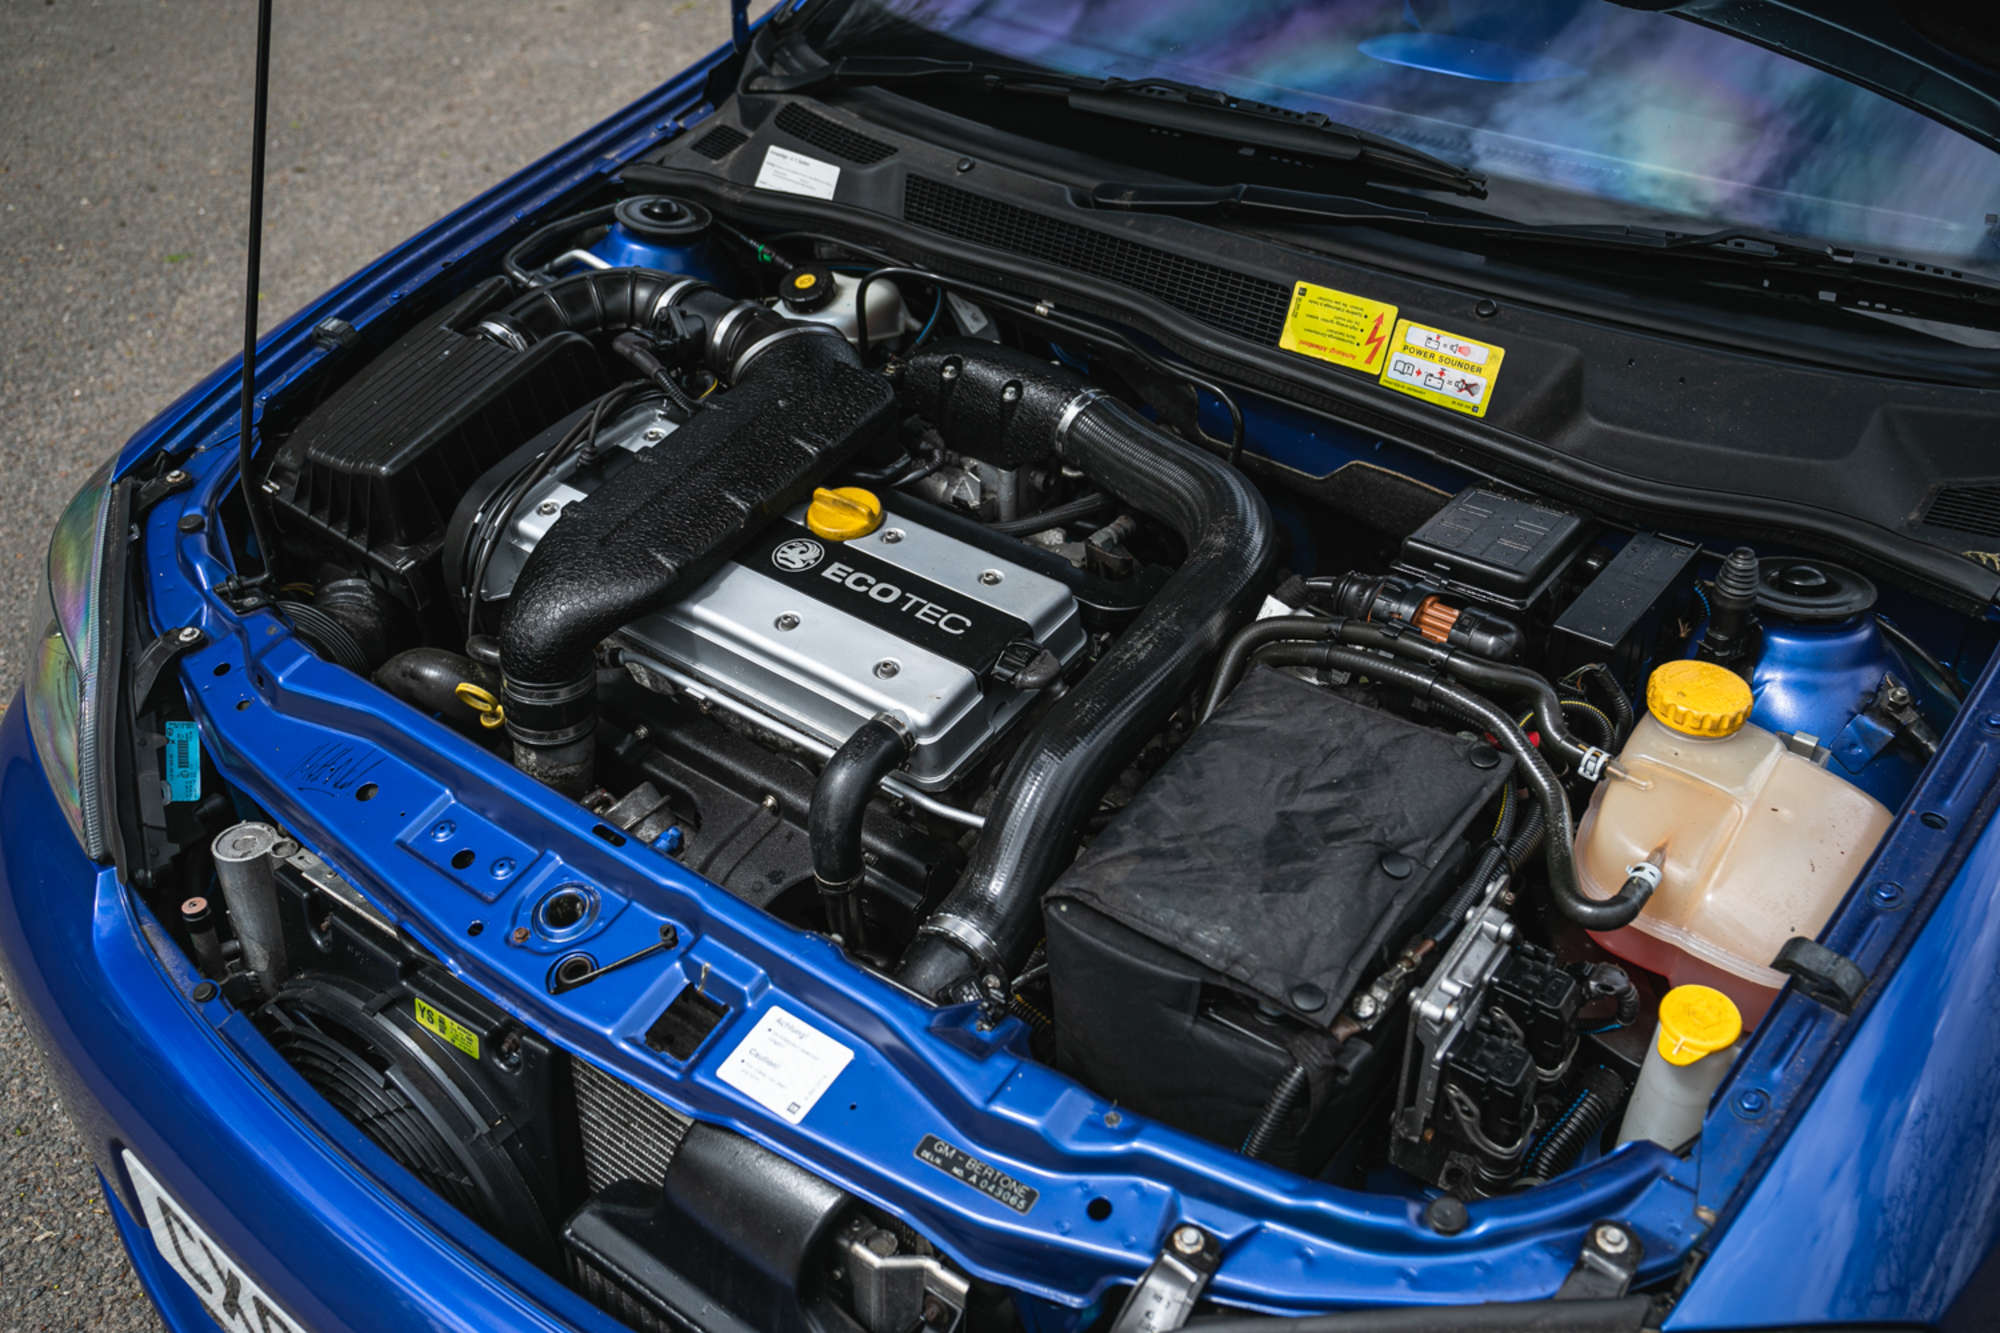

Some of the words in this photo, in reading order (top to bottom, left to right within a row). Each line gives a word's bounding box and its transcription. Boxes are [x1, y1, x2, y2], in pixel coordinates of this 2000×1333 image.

[1402, 344, 1436, 360] POWER
[1438, 354, 1483, 374] SOUNDER
[821, 562, 972, 635] ECOTEC
[934, 1141, 957, 1159] GM
[965, 1157, 1031, 1199] BERTONE
